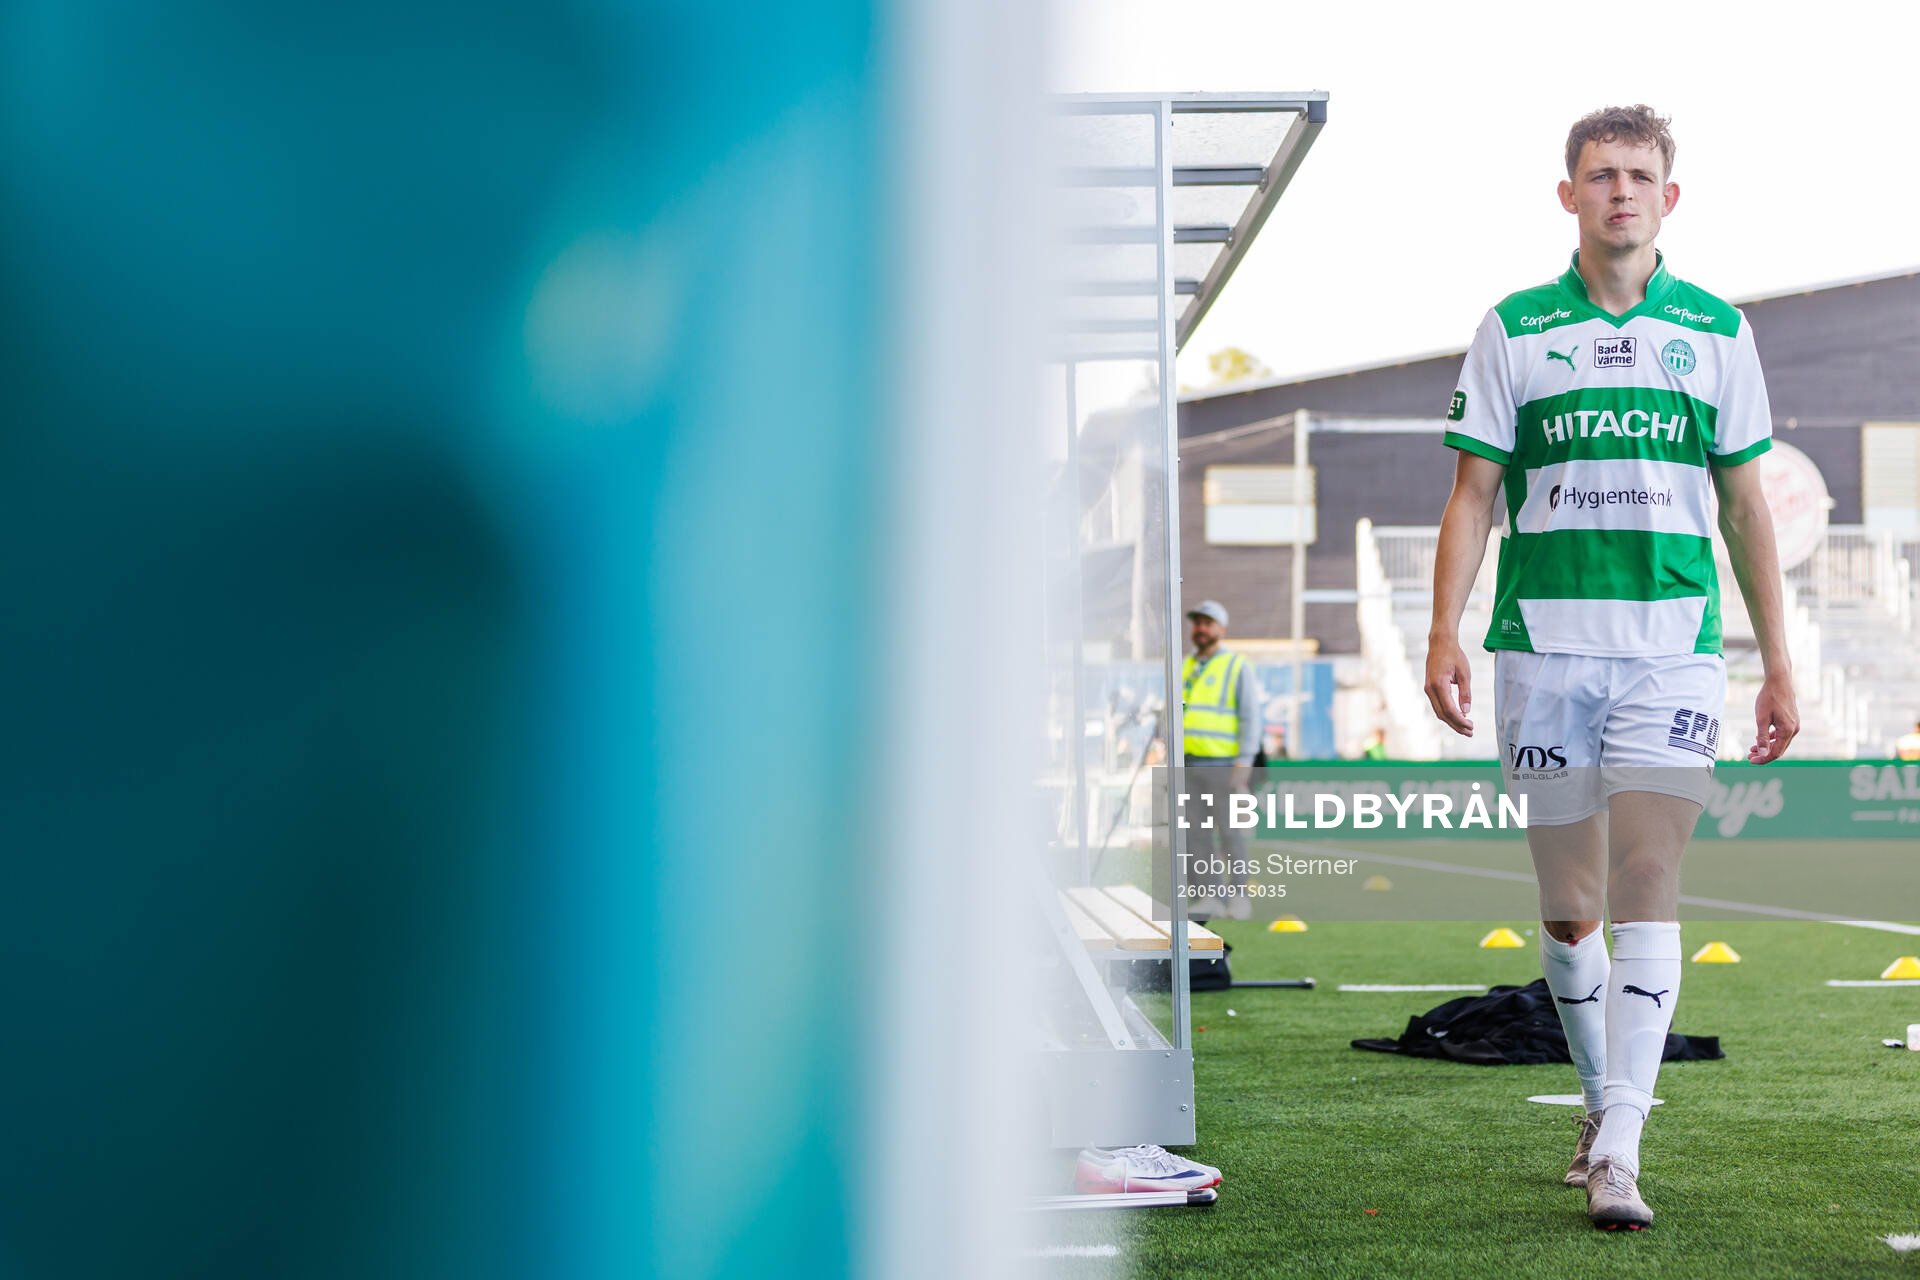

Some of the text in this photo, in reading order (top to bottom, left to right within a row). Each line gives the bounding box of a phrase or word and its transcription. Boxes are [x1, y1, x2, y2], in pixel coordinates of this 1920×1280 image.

[1520, 309, 1572, 331] Carpenter
[1664, 305, 1715, 324] Carpenter
[1598, 340, 1633, 354] Bad &
[1597, 354, 1633, 365] Värme
[1542, 410, 1688, 445] HITACHI
[1522, 771, 1568, 780] BILGLAS
